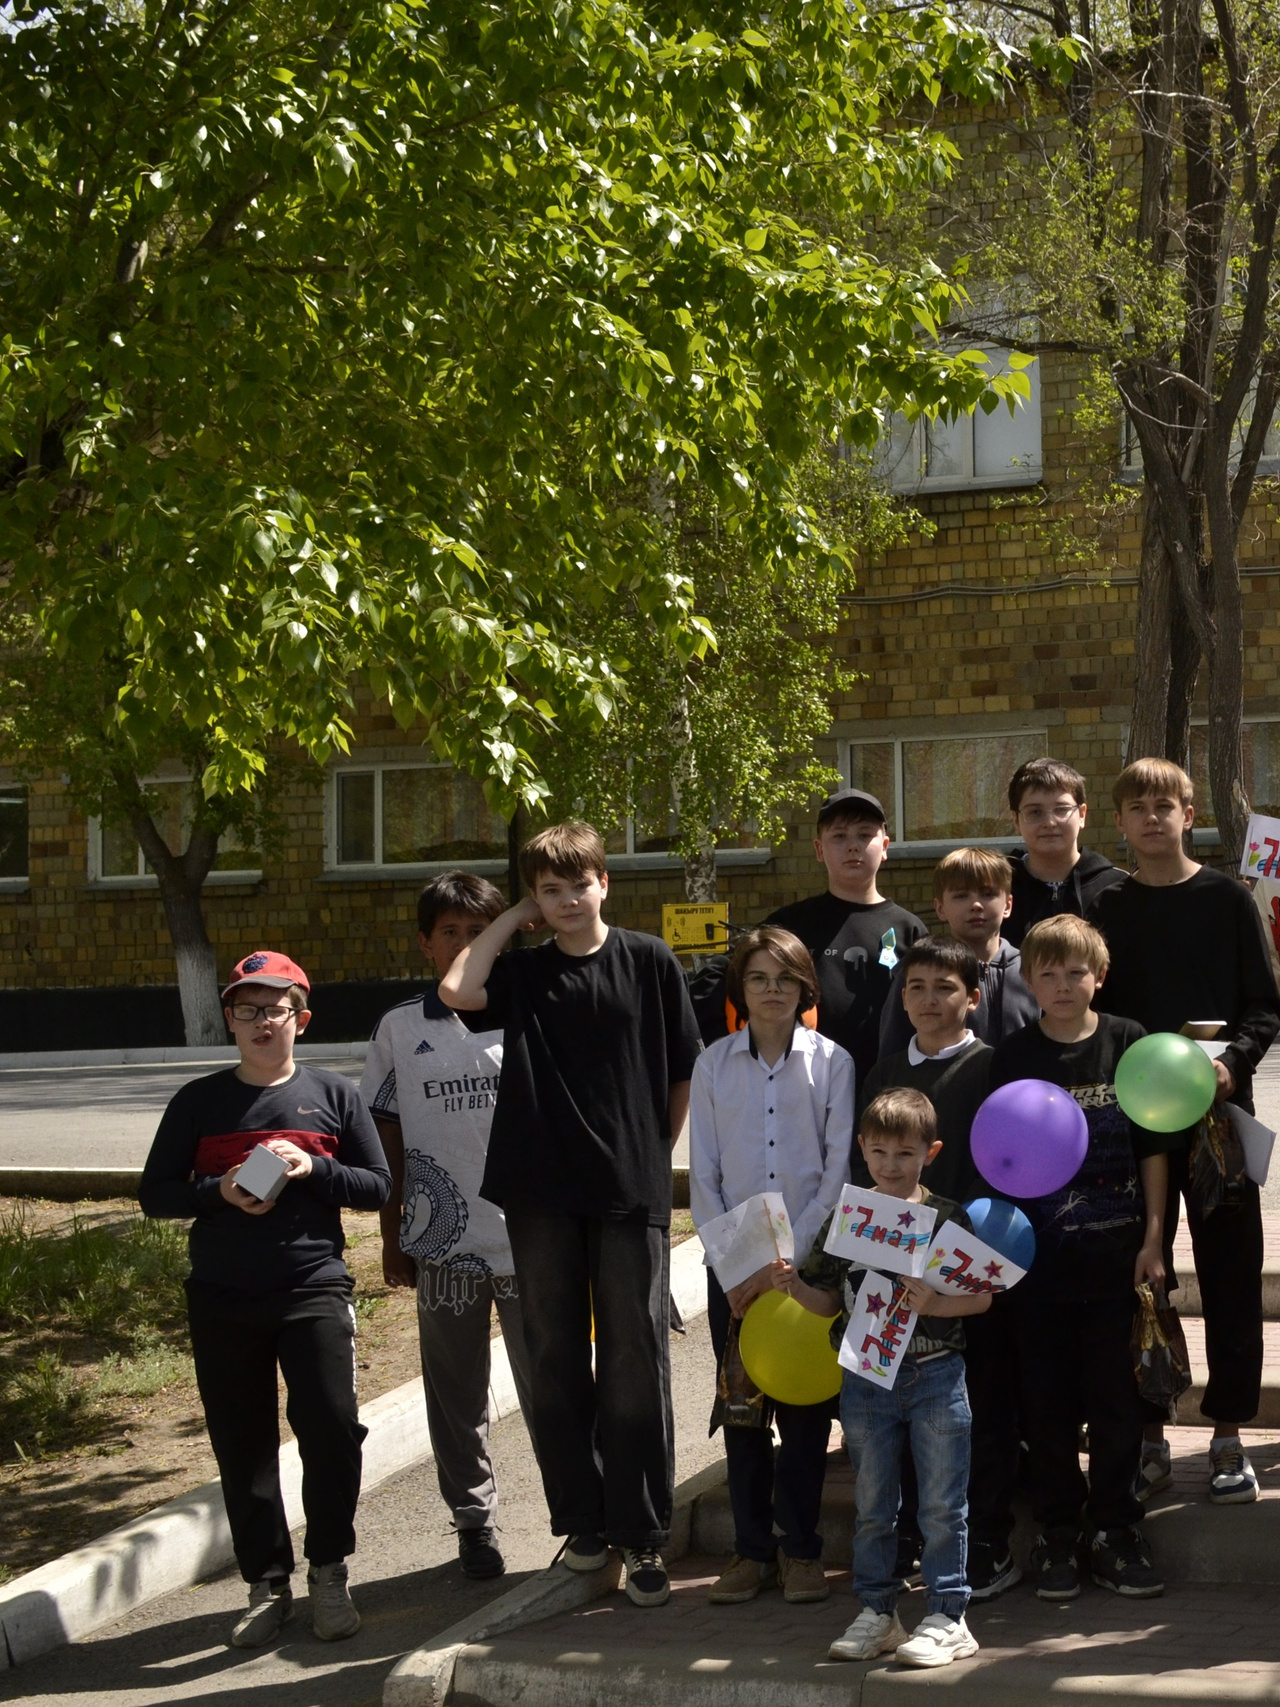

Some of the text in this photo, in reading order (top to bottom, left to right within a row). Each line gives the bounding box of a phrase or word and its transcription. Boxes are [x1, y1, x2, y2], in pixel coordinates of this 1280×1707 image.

[1263, 837, 1280, 877] 7
[444, 1096, 464, 1113] FLY
[855, 1205, 874, 1238] 7
[944, 1247, 974, 1285] 7
[860, 1333, 896, 1360] 7
